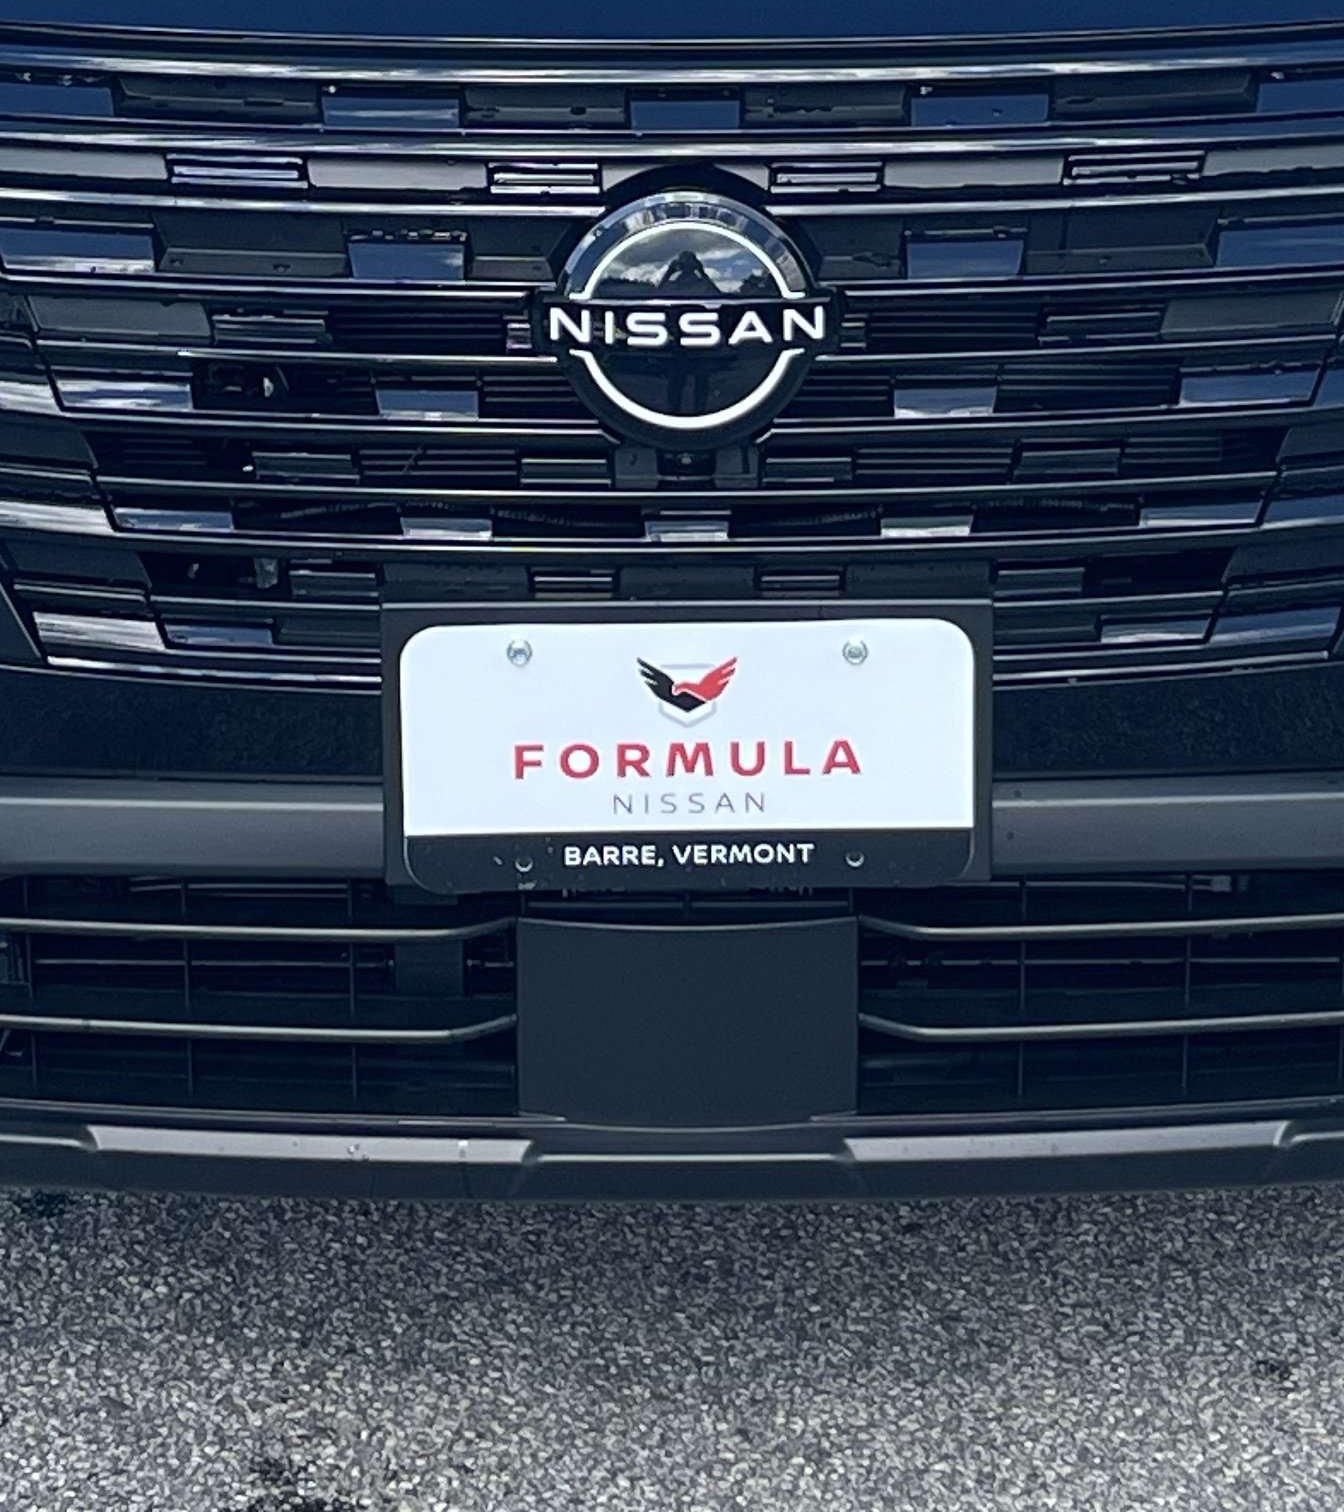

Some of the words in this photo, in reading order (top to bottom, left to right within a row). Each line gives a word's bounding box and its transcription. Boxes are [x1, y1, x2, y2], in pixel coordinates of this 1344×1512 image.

[549, 306, 825, 346] NISSAN
[513, 738, 863, 780] FORMULA
[612, 791, 767, 815] NISSAN
[563, 844, 665, 868] BARRE,
[672, 842, 815, 865] VERMONT
